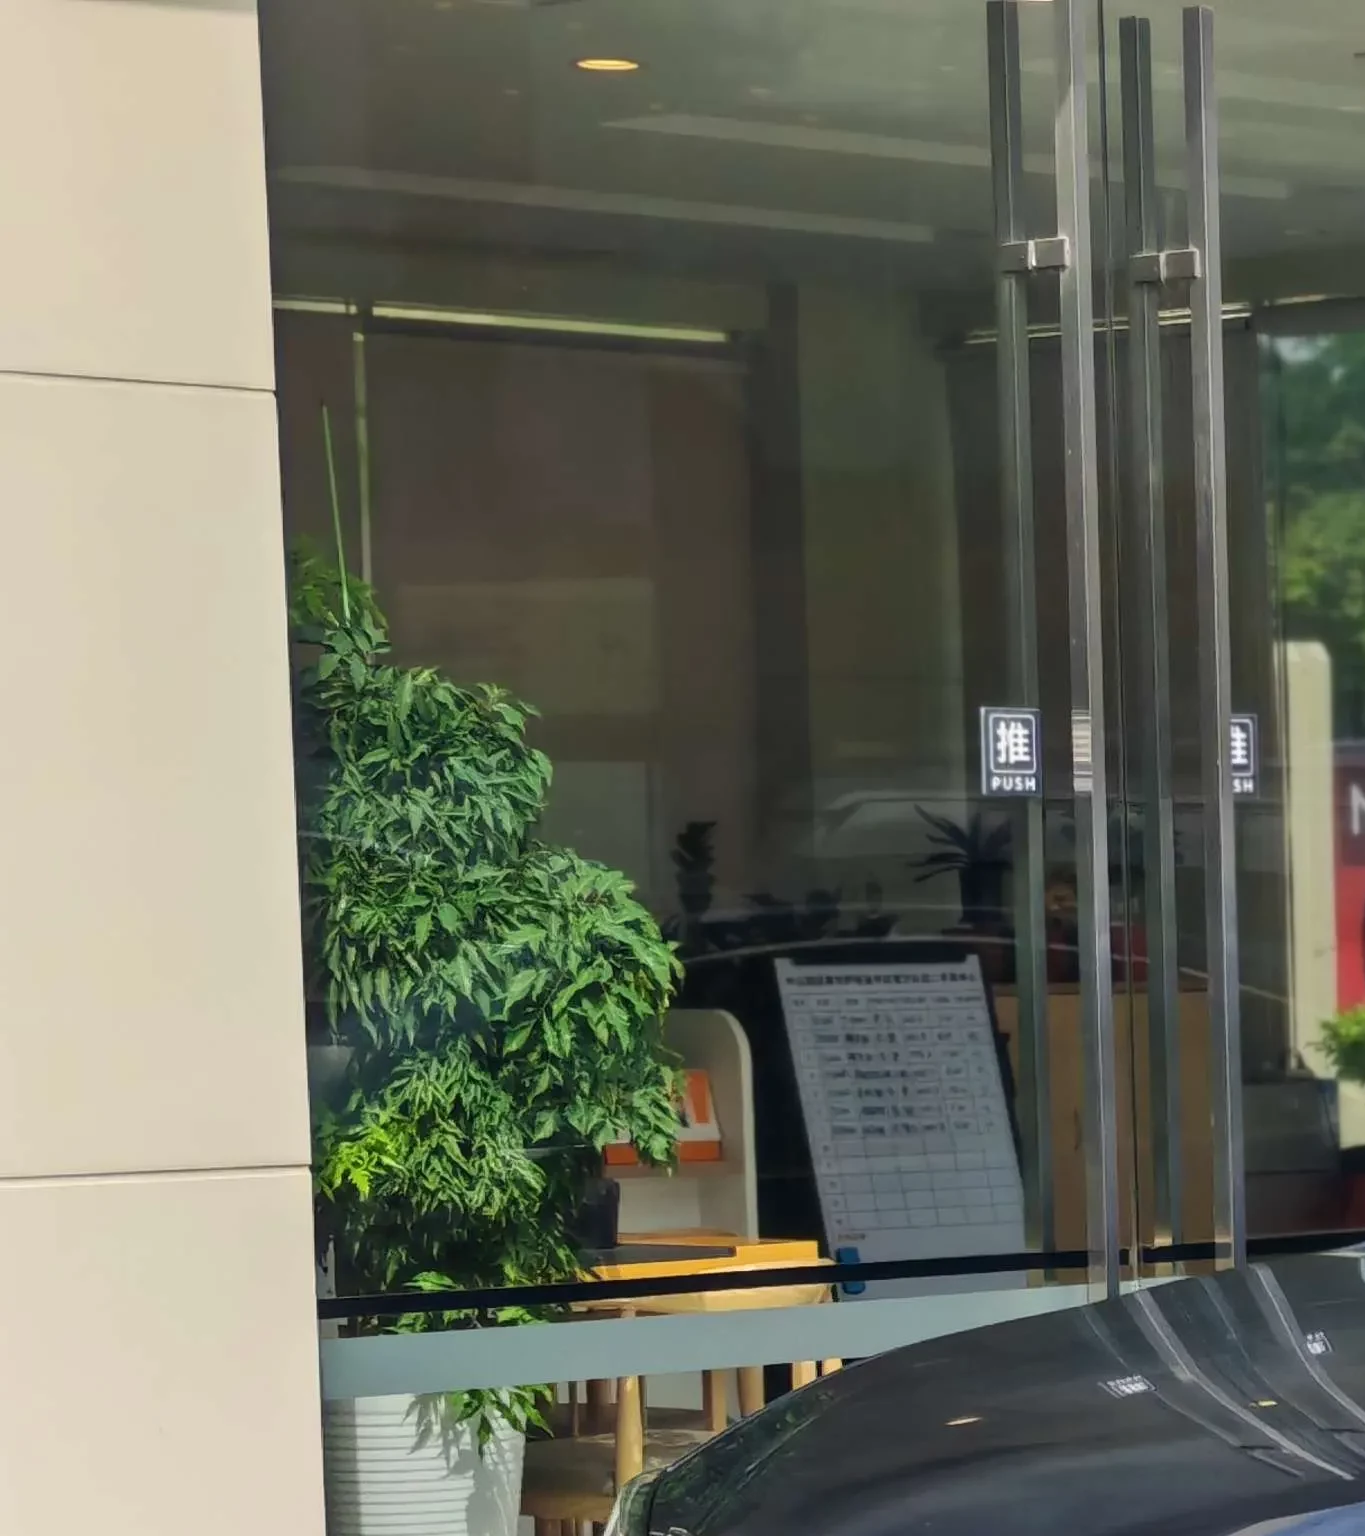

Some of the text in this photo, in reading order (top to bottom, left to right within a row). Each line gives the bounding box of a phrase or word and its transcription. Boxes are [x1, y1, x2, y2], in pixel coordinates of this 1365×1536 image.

[996, 720, 1032, 764] 推
[992, 776, 1036, 791] PUSH
[1232, 778, 1254, 793] SH
